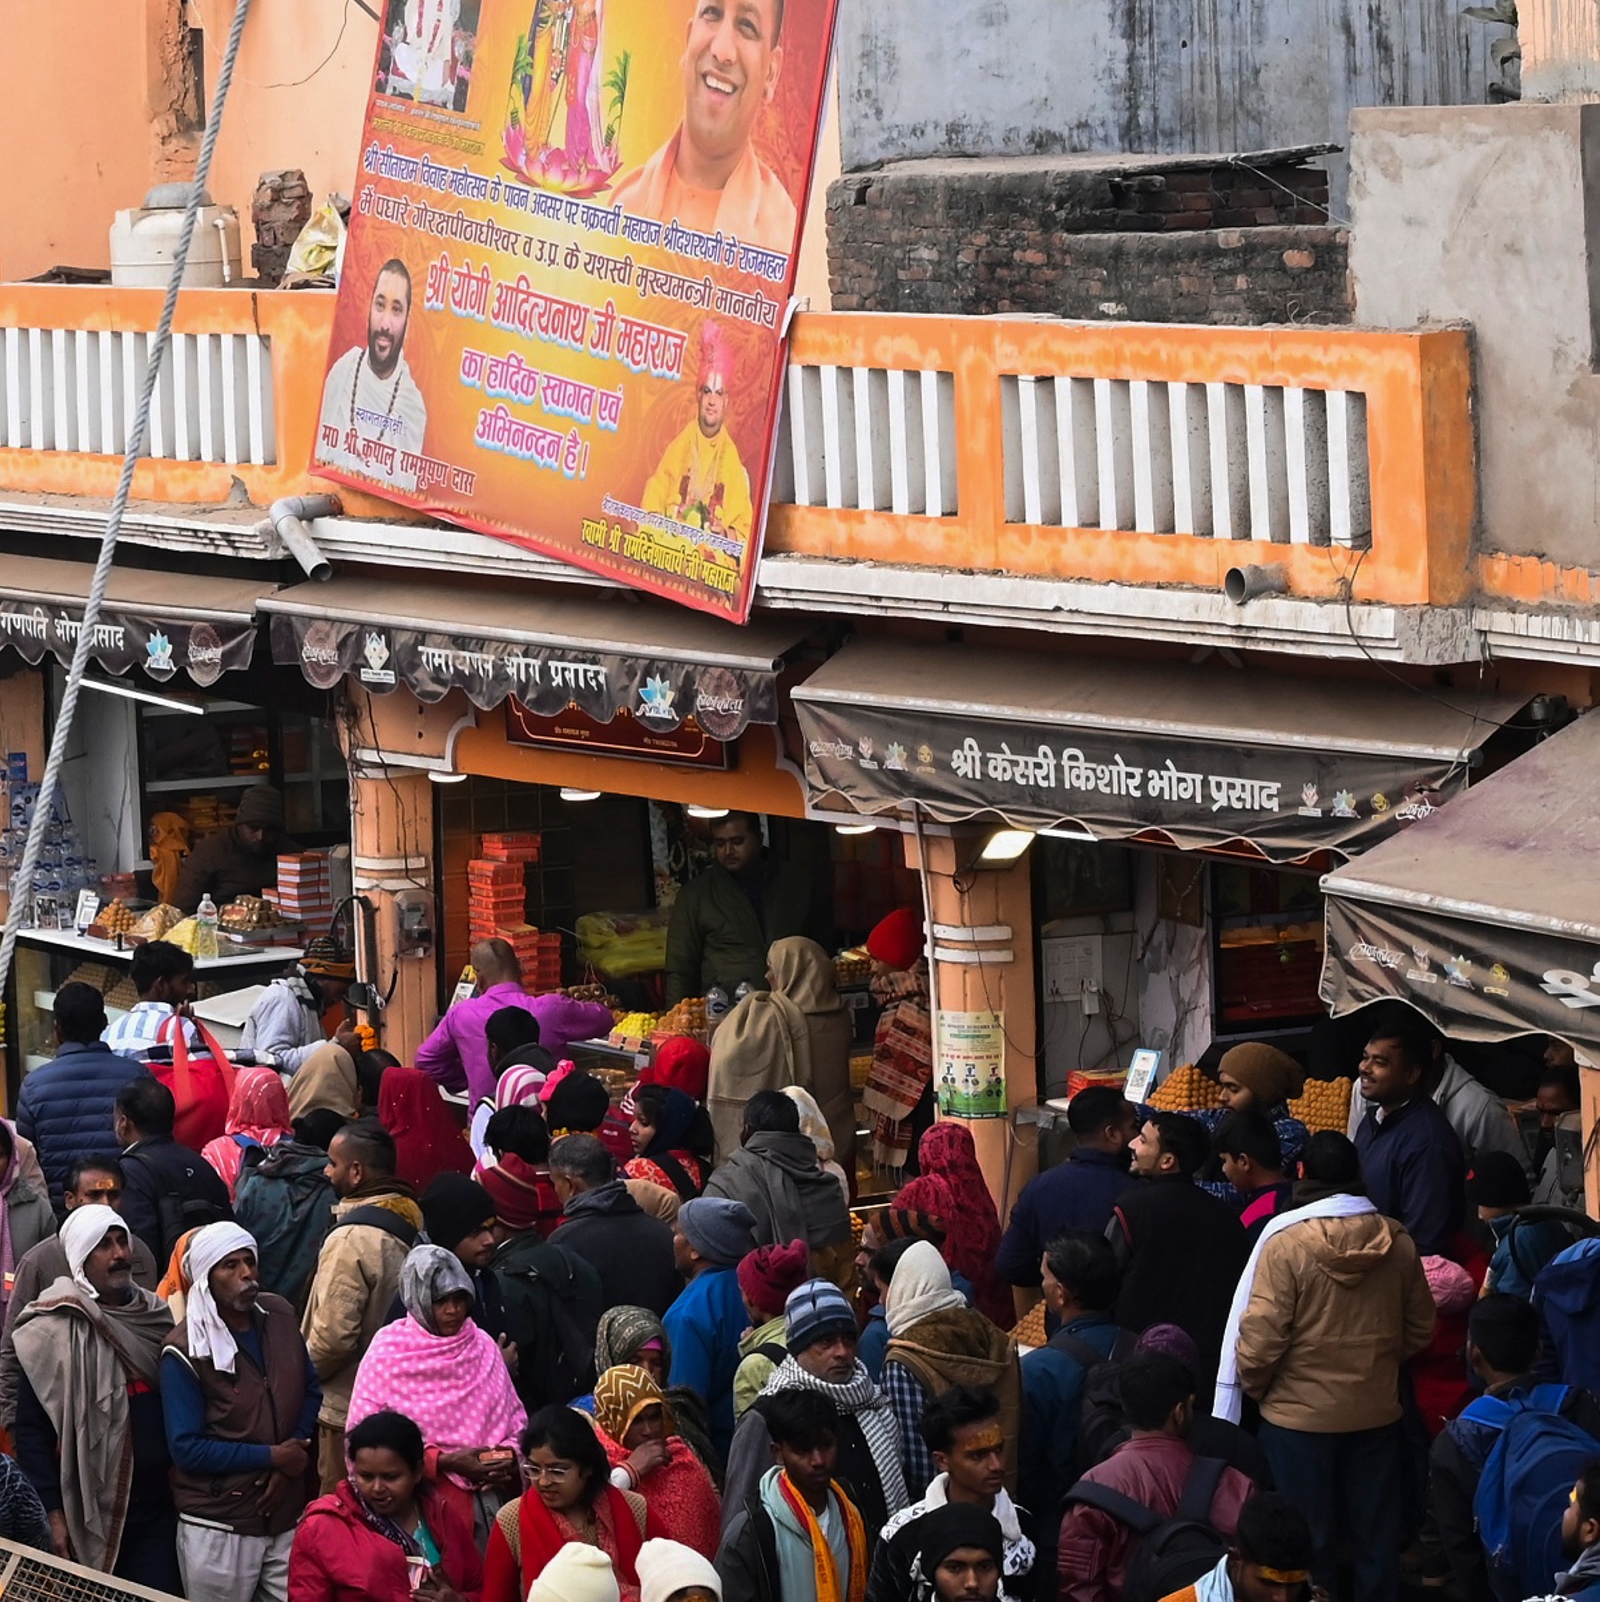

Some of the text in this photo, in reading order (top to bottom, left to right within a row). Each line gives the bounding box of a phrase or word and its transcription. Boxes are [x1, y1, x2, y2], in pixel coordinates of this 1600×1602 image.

[364, 143, 379, 174] श्री
[378, 145, 419, 183] सीताराम
[419, 155, 449, 190] विवाह
[448, 165, 490, 200] महोत्सव
[490, 174, 504, 203] के
[503, 183, 531, 208] पावन
[530, 191, 564, 221] अवसर
[563, 200, 581, 225] पर
[621, 214, 663, 246] महाराज
[723, 235, 739, 267] के
[738, 243, 789, 283] राजमहल
[425, 253, 689, 378] श्री योगी आदित्यनाथ जी महाराज
[522, 234, 535, 259] व
[563, 241, 582, 271] के
[583, 252, 635, 287] यशस्वी
[714, 287, 779, 327] माननीय
[461, 349, 624, 429] का हार्दिक स्वागत एवं
[344, 428, 359, 456] श्री
[361, 437, 398, 476] कृपालु
[451, 466, 477, 495] दास
[475, 404, 564, 465] अभिनन्दन
[581, 517, 608, 549] स्वामी
[608, 524, 623, 554] श्री
[685, 548, 701, 582] जी
[701, 558, 740, 595] महाराज
[0, 604, 49, 641] गणपति
[950, 736, 1281, 814] श्री केसरी किशोर भोग प्रसाद
